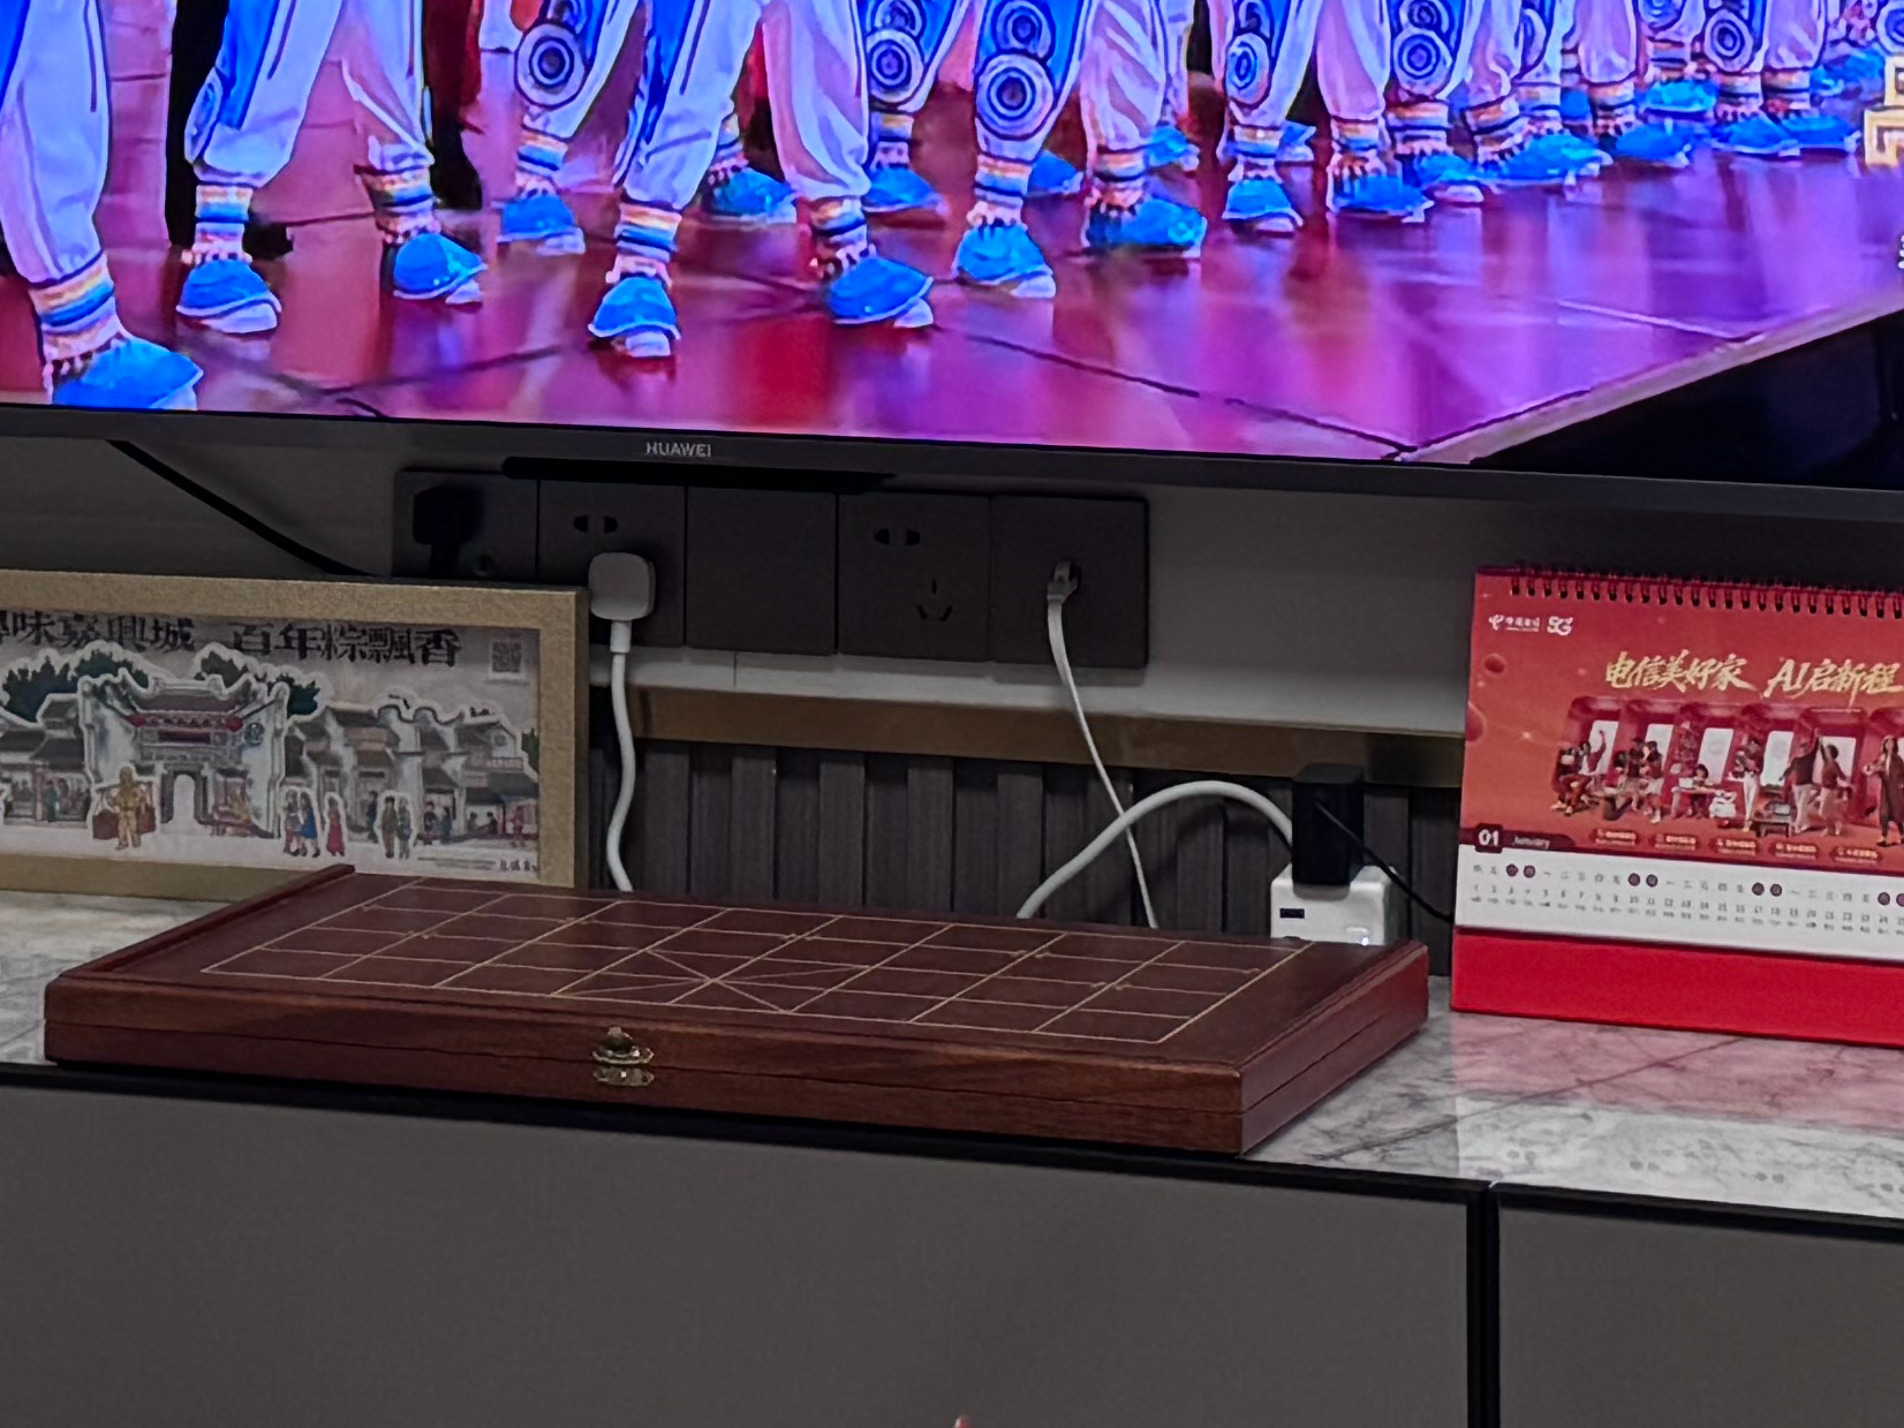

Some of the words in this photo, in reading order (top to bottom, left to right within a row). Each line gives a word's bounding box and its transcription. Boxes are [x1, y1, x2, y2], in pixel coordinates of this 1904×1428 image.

[646, 442, 711, 458] HUAWEI
[1547, 616, 1573, 636] 5G
[227, 620, 462, 668] 百年粽飄香
[1606, 649, 1760, 692] 电信美好家
[1763, 658, 1904, 707] AI启新程
[1478, 829, 1499, 847] 01
